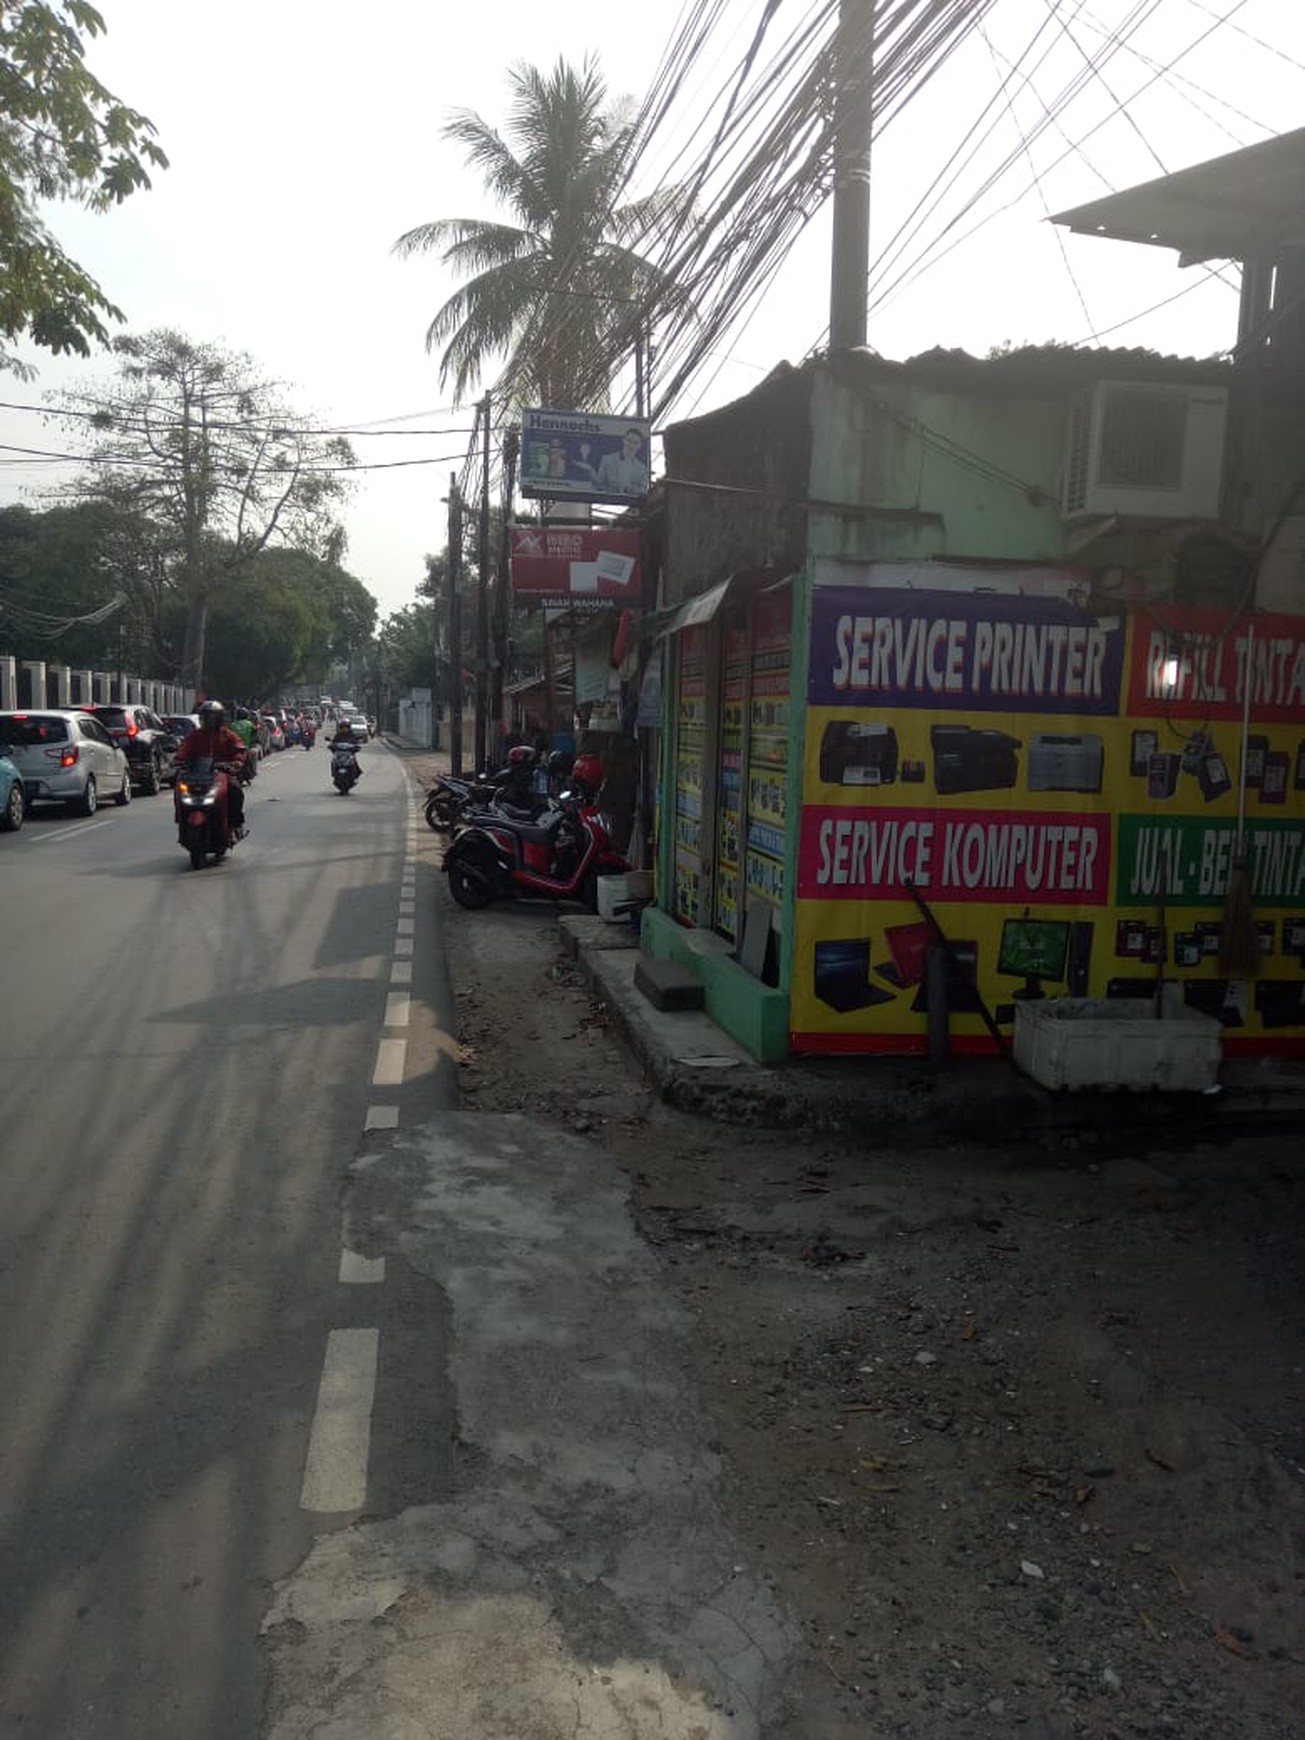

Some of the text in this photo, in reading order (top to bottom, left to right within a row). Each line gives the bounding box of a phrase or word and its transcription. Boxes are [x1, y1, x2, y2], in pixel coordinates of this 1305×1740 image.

[833, 615, 1107, 697] SERVICE PRINTER
[816, 819, 934, 888] SERVICE
[942, 822, 1099, 892] KOMPUTER
[1198, 828, 1249, 897] BE
